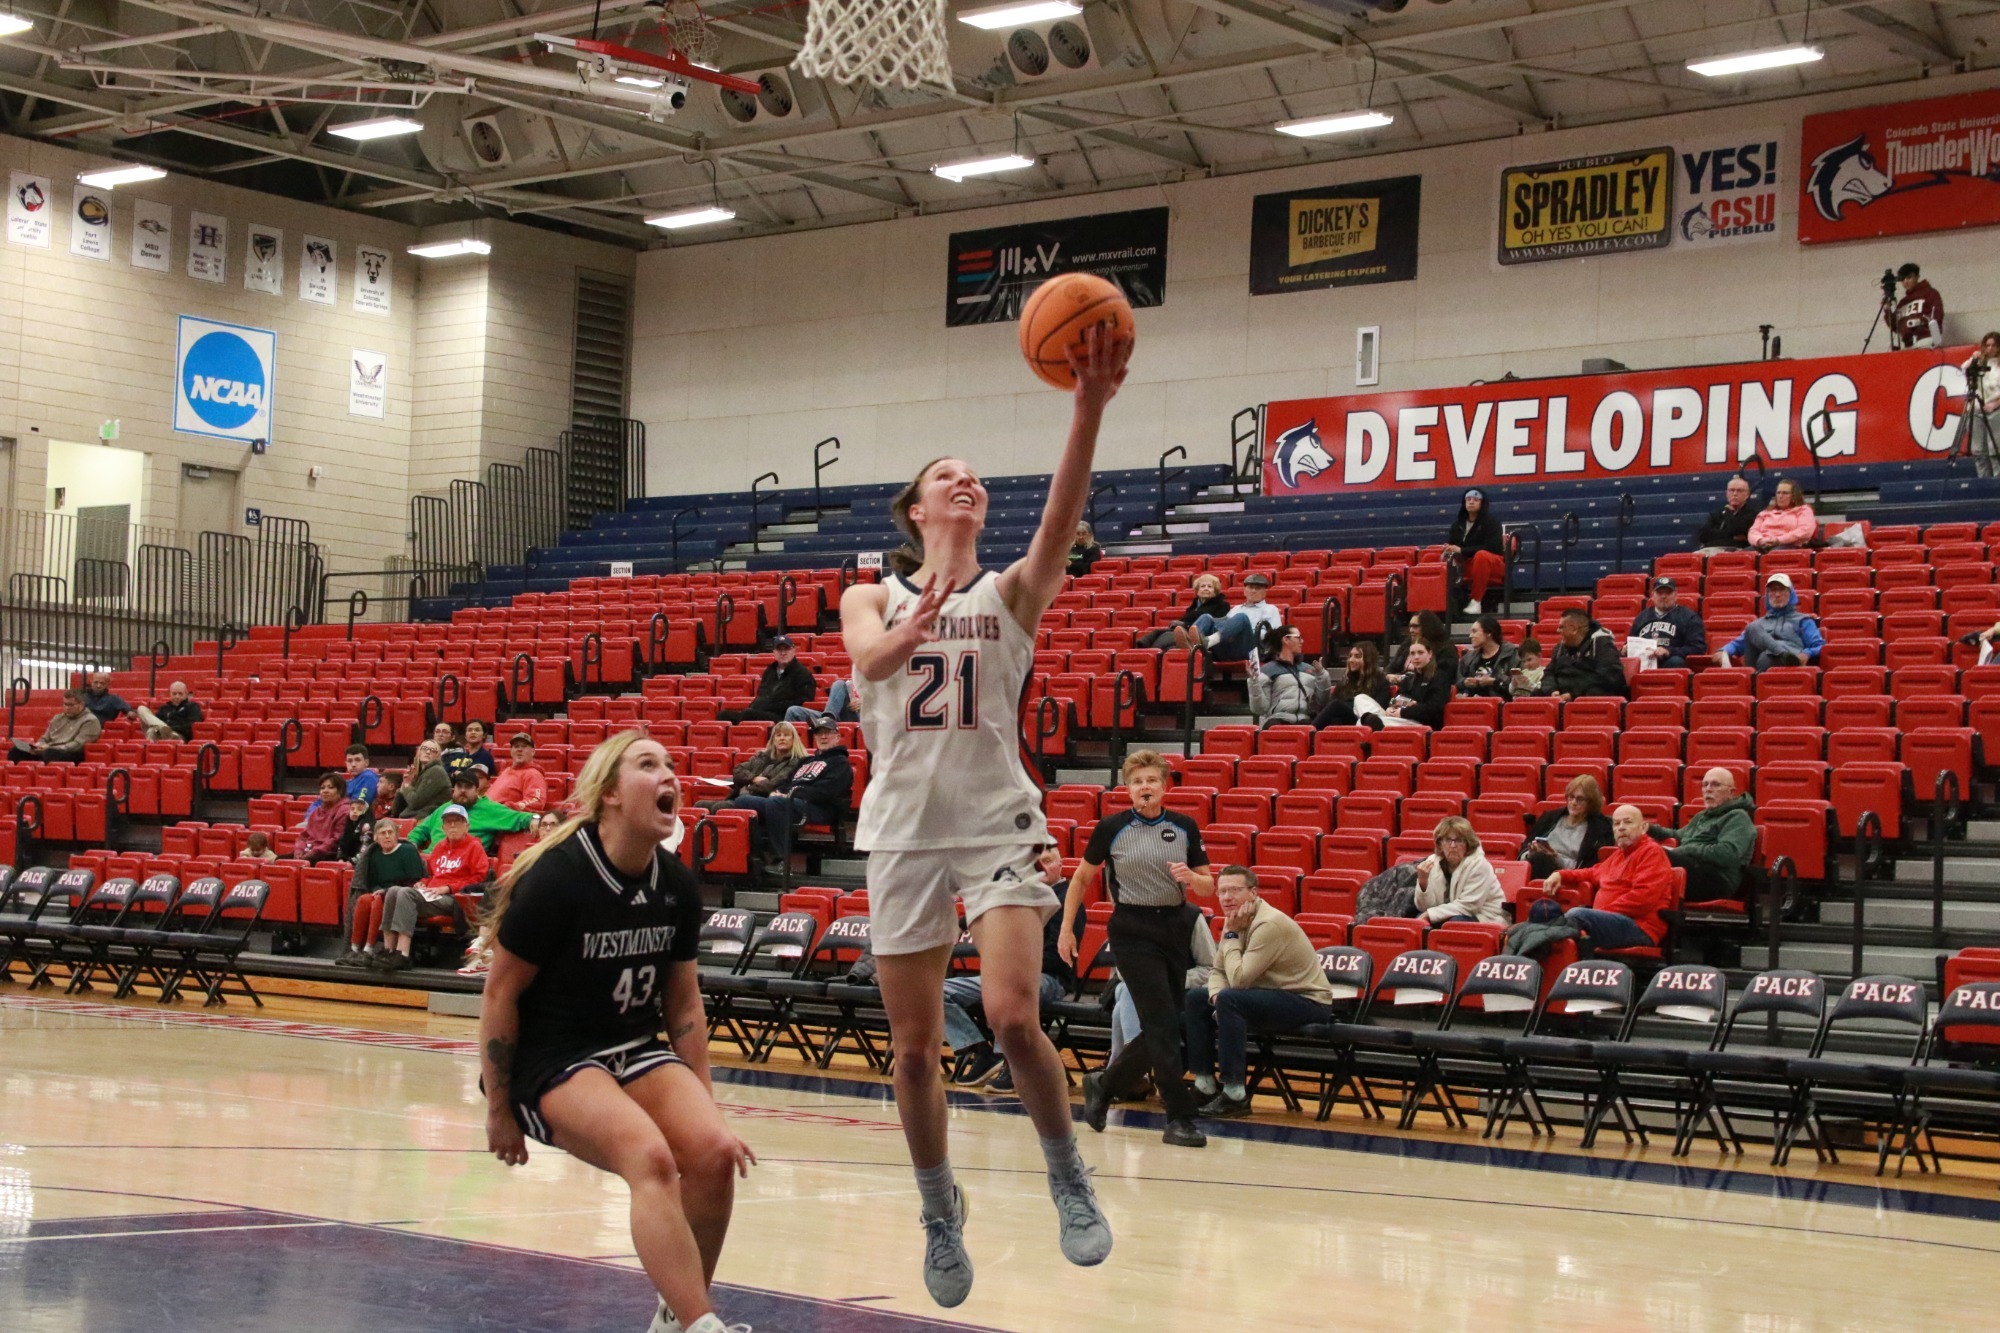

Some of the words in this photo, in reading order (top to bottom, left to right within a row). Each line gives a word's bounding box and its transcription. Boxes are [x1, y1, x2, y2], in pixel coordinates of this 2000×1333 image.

[596, 57, 605, 73] 3
[1886, 125, 1928, 139] Colorado
[1931, 121, 1957, 133] State
[1557, 156, 1615, 171] PUEBLO
[1682, 142, 1777, 195] YES!
[1513, 166, 1660, 230] SPRADLEY
[1298, 202, 1369, 235] DICKEY'S
[1710, 193, 1776, 229] CSU
[85, 231, 97, 239] Fort
[1521, 229, 1544, 245] OH
[1548, 225, 1575, 242] YES
[1577, 221, 1608, 237] YOU
[1612, 217, 1648, 234] CAN!
[1708, 222, 1775, 239] PUEBLO
[80, 244, 100, 254] College
[82, 237, 99, 246] Lewis
[144, 242, 159, 252] MSU
[1302, 232, 1345, 250] BARBECUE
[1347, 231, 1362, 245] PIT
[1508, 233, 1658, 260] WWW.SPRADLEY.COM
[140, 249, 162, 259] Denver
[1071, 246, 1157, 264] www.mxvrail.com
[1110, 262, 1149, 274] Momentum
[1278, 274, 1302, 284] YOUR
[1304, 270, 1346, 282] CATERING
[1347, 265, 1388, 277] EXPERTS
[190, 374, 262, 410] NCAA
[1343, 372, 1859, 484] DEVELOPING
[859, 557, 881, 565] SECTION
[1651, 621, 1677, 637] PUEBLO
[906, 650, 979, 732] 21
[1162, 831, 1176, 839] JWH
[100, 882, 131, 896] PACK
[142, 878, 172, 892] PACK
[187, 881, 217, 895] PACK
[231, 884, 262, 898] PACK
[708, 913, 748, 929] PACK
[770, 916, 809, 933] PACK
[1393, 956, 1448, 975] PACK
[1476, 961, 1533, 981] PACK
[1563, 967, 1623, 986] PACK
[1656, 971, 1717, 991] PACK
[612, 964, 657, 1015] 43
[1752, 976, 1816, 996] PACK
[1850, 982, 1917, 1004] PACK
